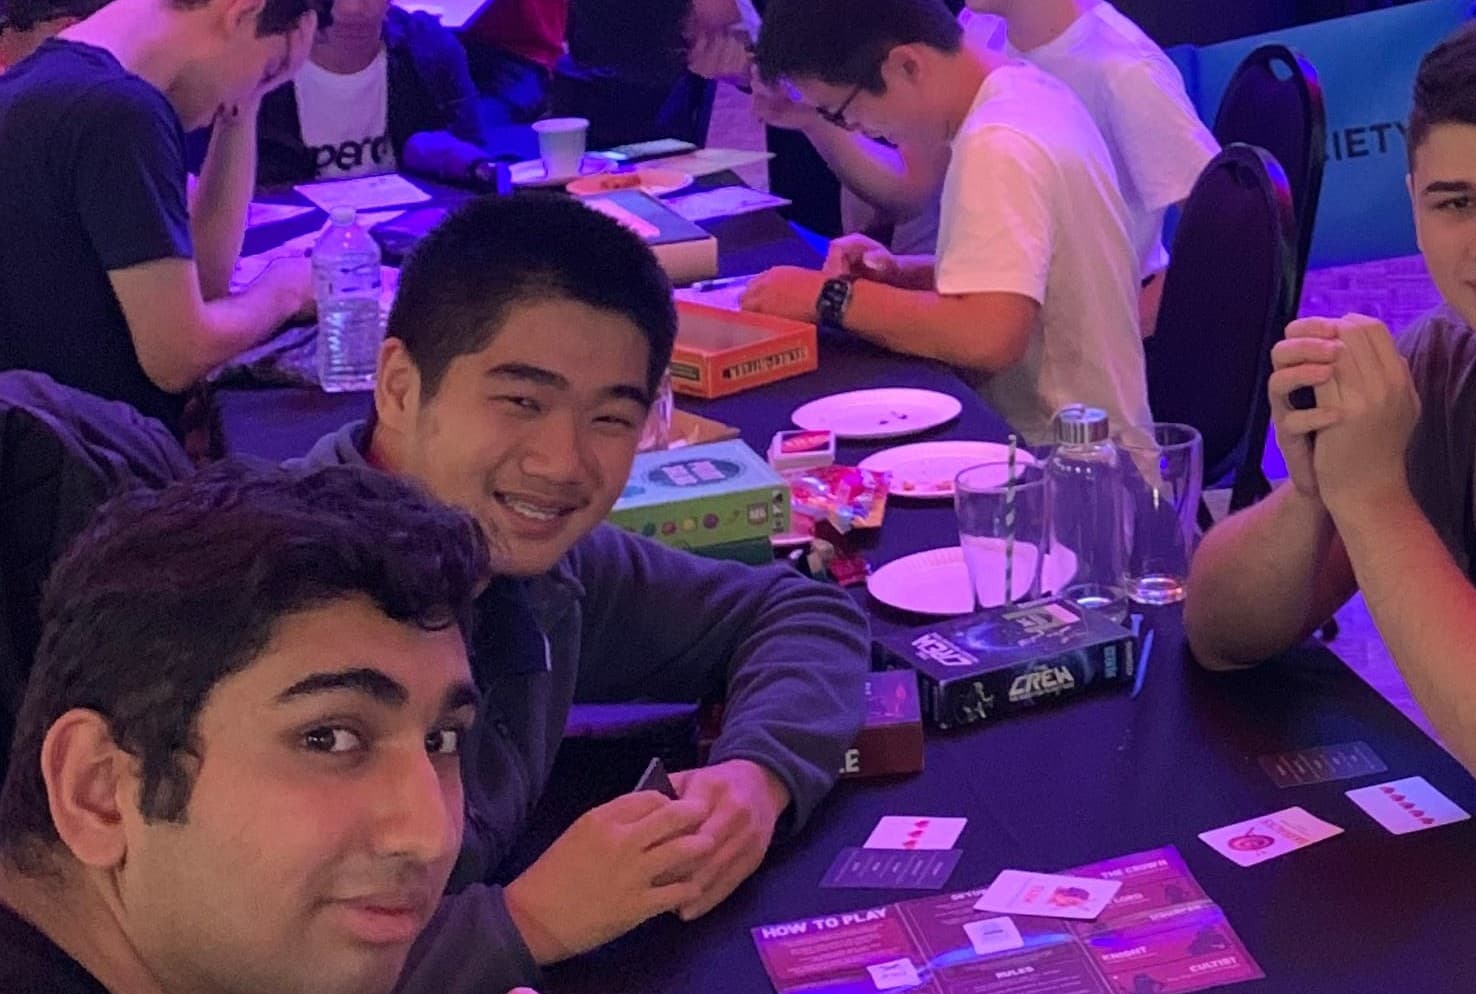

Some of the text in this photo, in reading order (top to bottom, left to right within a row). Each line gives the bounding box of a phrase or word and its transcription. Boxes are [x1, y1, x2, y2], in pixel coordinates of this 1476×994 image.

[1321, 121, 1410, 163] IET
[1009, 664, 1074, 698] CREW
[761, 908, 888, 940] HOW TO PLAY
[1101, 946, 1147, 961] KNIGHT
[1188, 956, 1237, 974] CULTIST
[995, 966, 1035, 979] RULES
